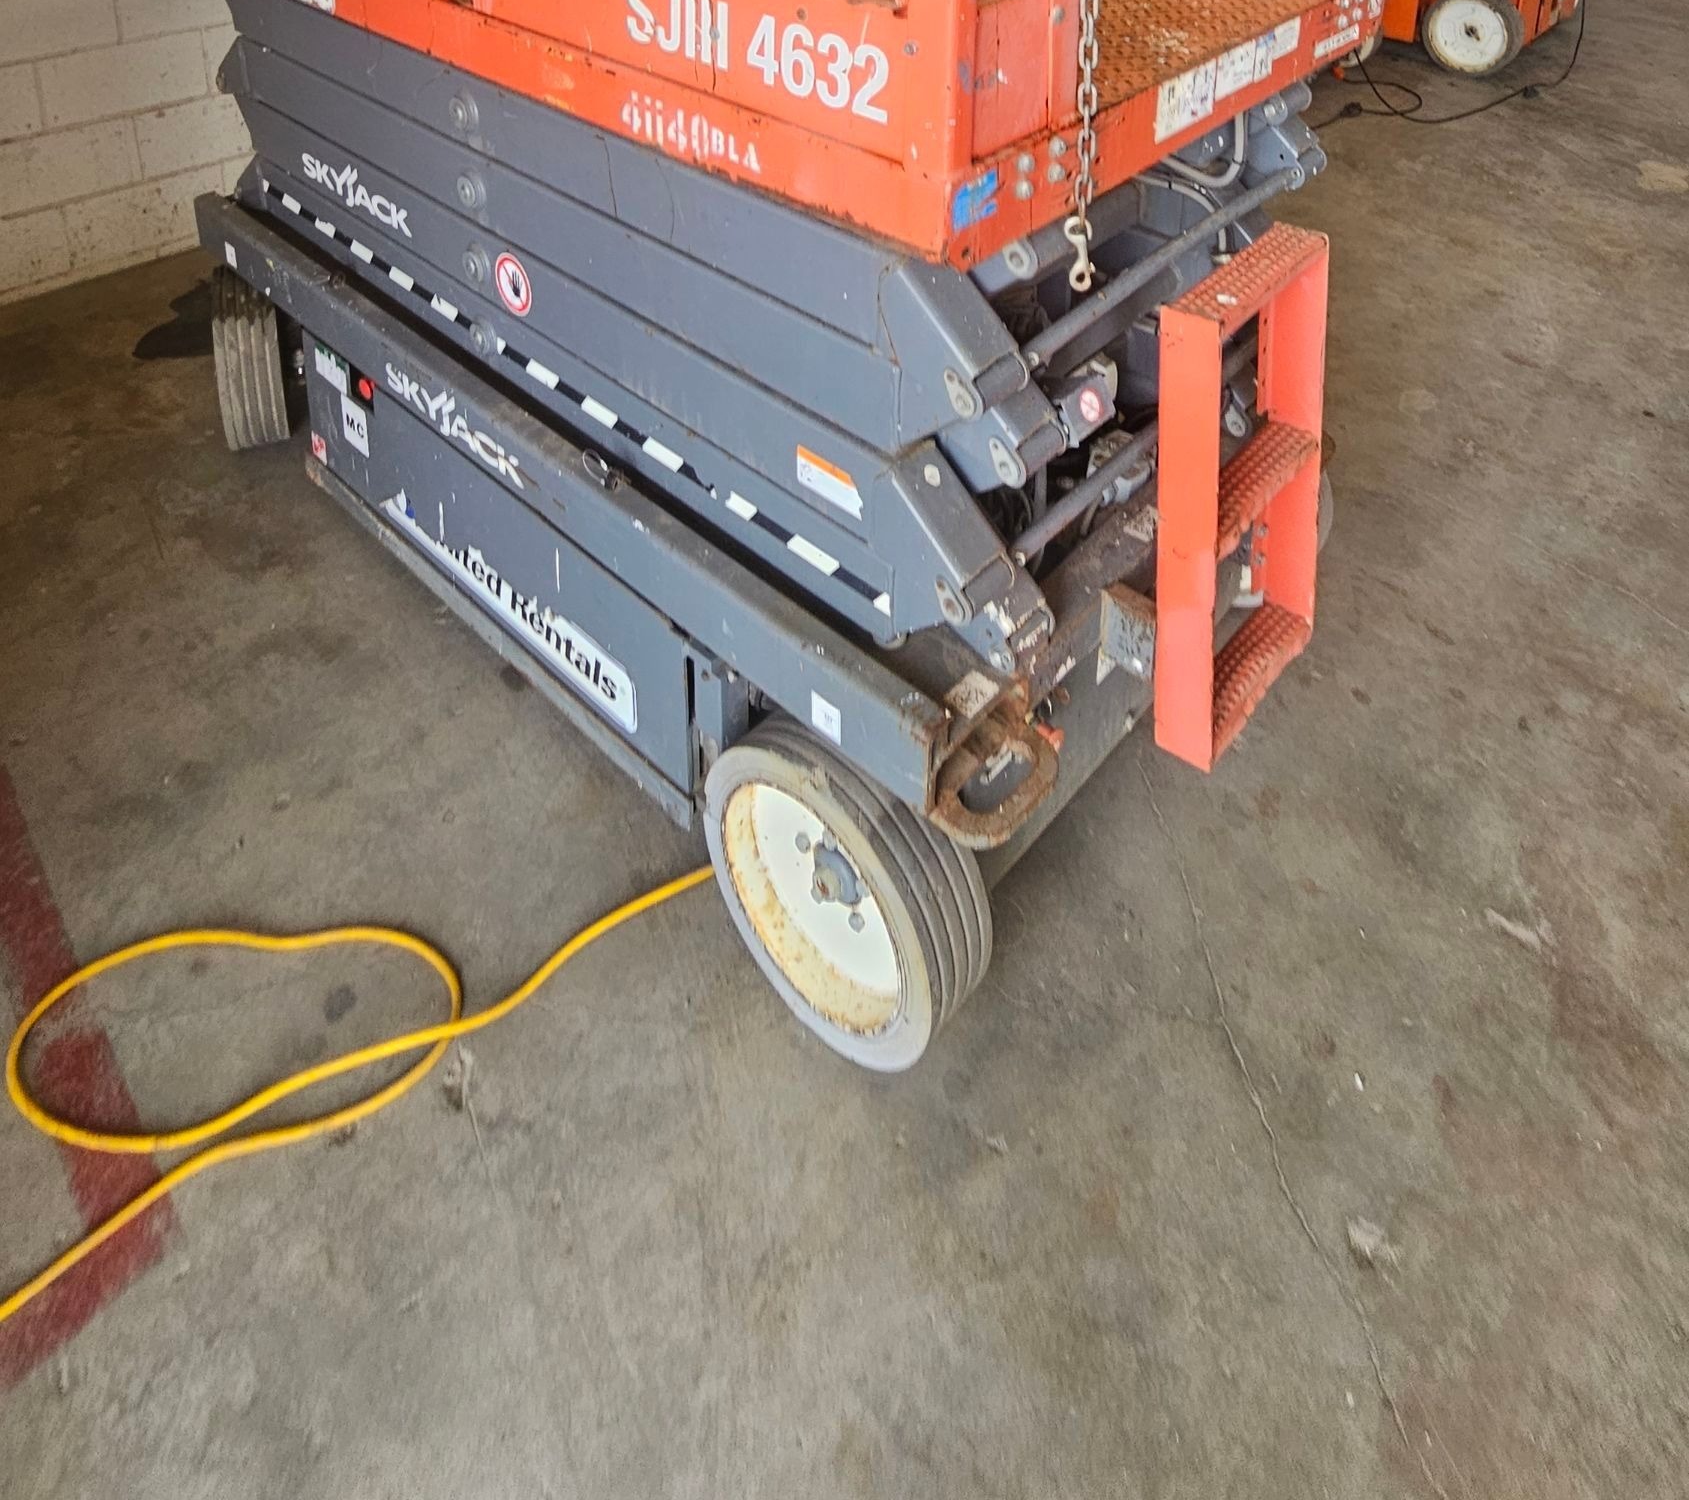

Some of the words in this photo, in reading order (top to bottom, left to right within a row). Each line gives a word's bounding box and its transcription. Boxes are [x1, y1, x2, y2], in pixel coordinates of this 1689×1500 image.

[747, 13, 890, 125] 4632
[302, 152, 412, 239] SKYJACK
[386, 362, 524, 489] SKYJACK
[511, 591, 618, 701] Rentals
